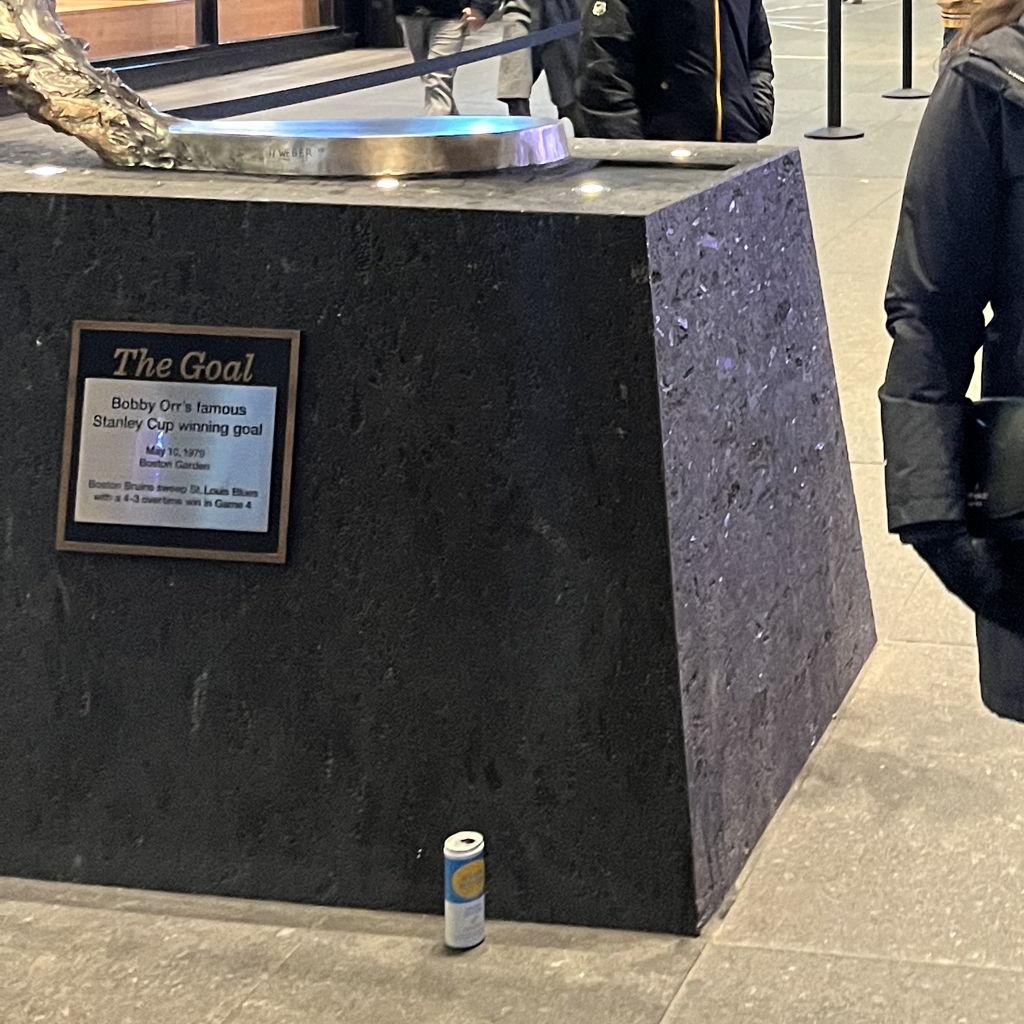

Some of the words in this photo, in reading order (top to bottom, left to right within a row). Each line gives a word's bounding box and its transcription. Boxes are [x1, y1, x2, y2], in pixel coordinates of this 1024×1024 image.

[113, 347, 173, 378] The
[180, 350, 255, 382] Goal
[111, 397, 156, 414] Bobby
[160, 399, 192, 413] Orr's
[197, 401, 247, 416] famous
[93, 415, 143, 432] Stanley
[147, 417, 174, 434] Cup
[178, 420, 229, 437] winning
[233, 423, 263, 438] goal
[146, 446, 165, 457] May
[139, 458, 172, 469] Boston
[175, 460, 210, 471] Garden
[88, 479, 122, 490] Boston
[124, 481, 154, 491] Bruins
[157, 484, 187, 495] sweep
[204, 485, 229, 496] Louis
[232, 487, 258, 498] Blues
[123, 494, 140, 503] 4-3
[141, 496, 183, 506] overtime
[203, 498, 213, 508] in
[214, 498, 243, 509] Game
[244, 500, 252, 509] 4
